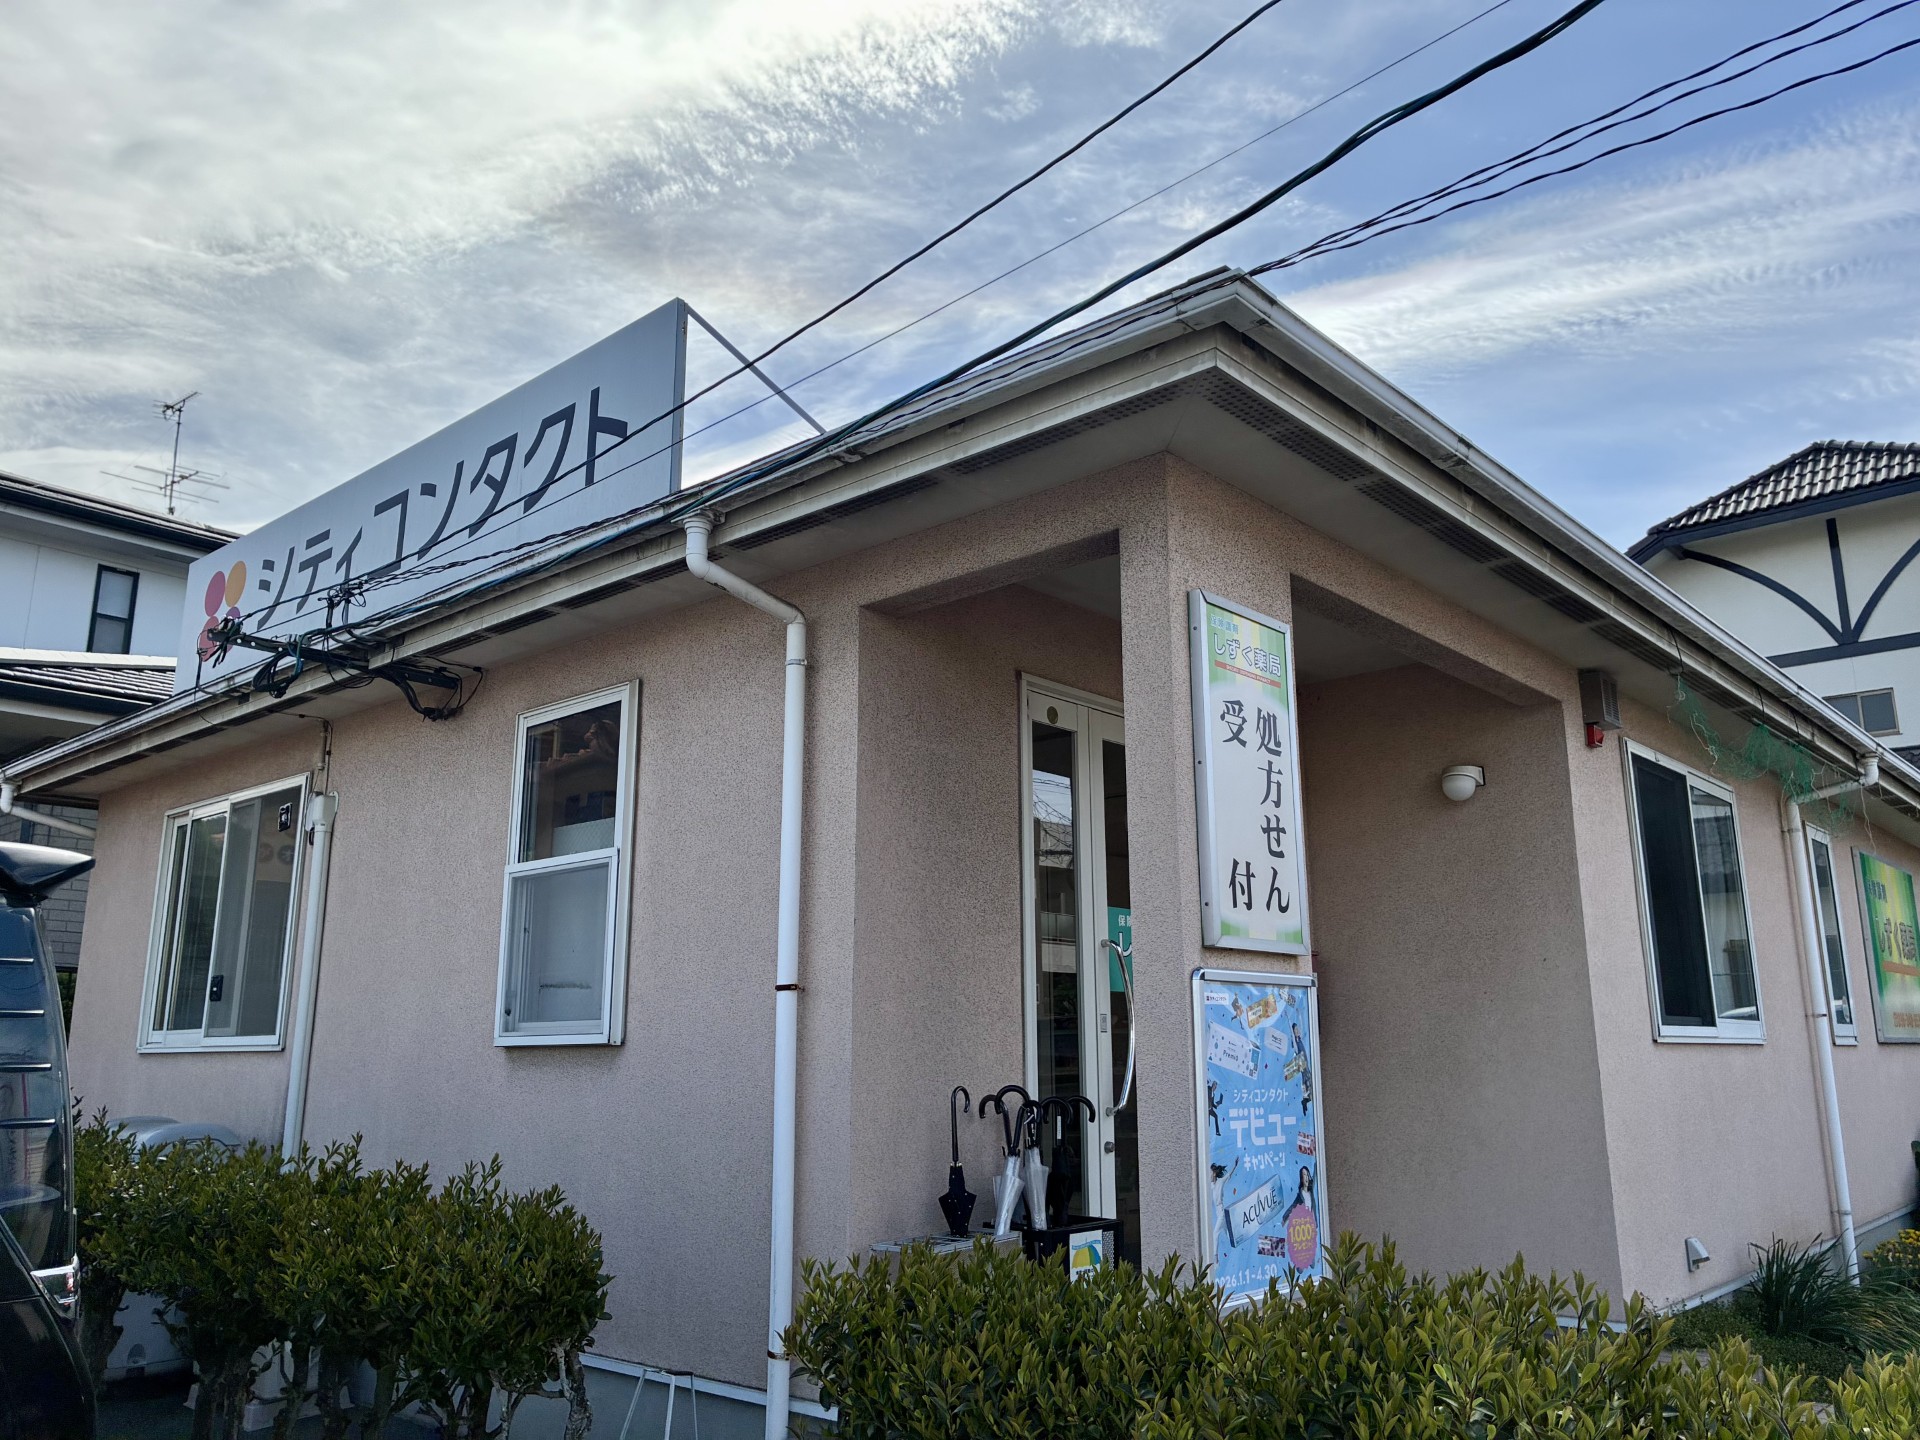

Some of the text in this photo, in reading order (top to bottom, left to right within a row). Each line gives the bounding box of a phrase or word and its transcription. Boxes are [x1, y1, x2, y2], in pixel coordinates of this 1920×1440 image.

[257, 386, 628, 630] シティコンタクト
[1213, 632, 1281, 678] しずく薬局
[1255, 706, 1291, 914] 処方せん
[1233, 1087, 1289, 1103] シティコンタクト
[1228, 1106, 1297, 1148] デビュー
[1243, 1150, 1286, 1172] キャンペーン
